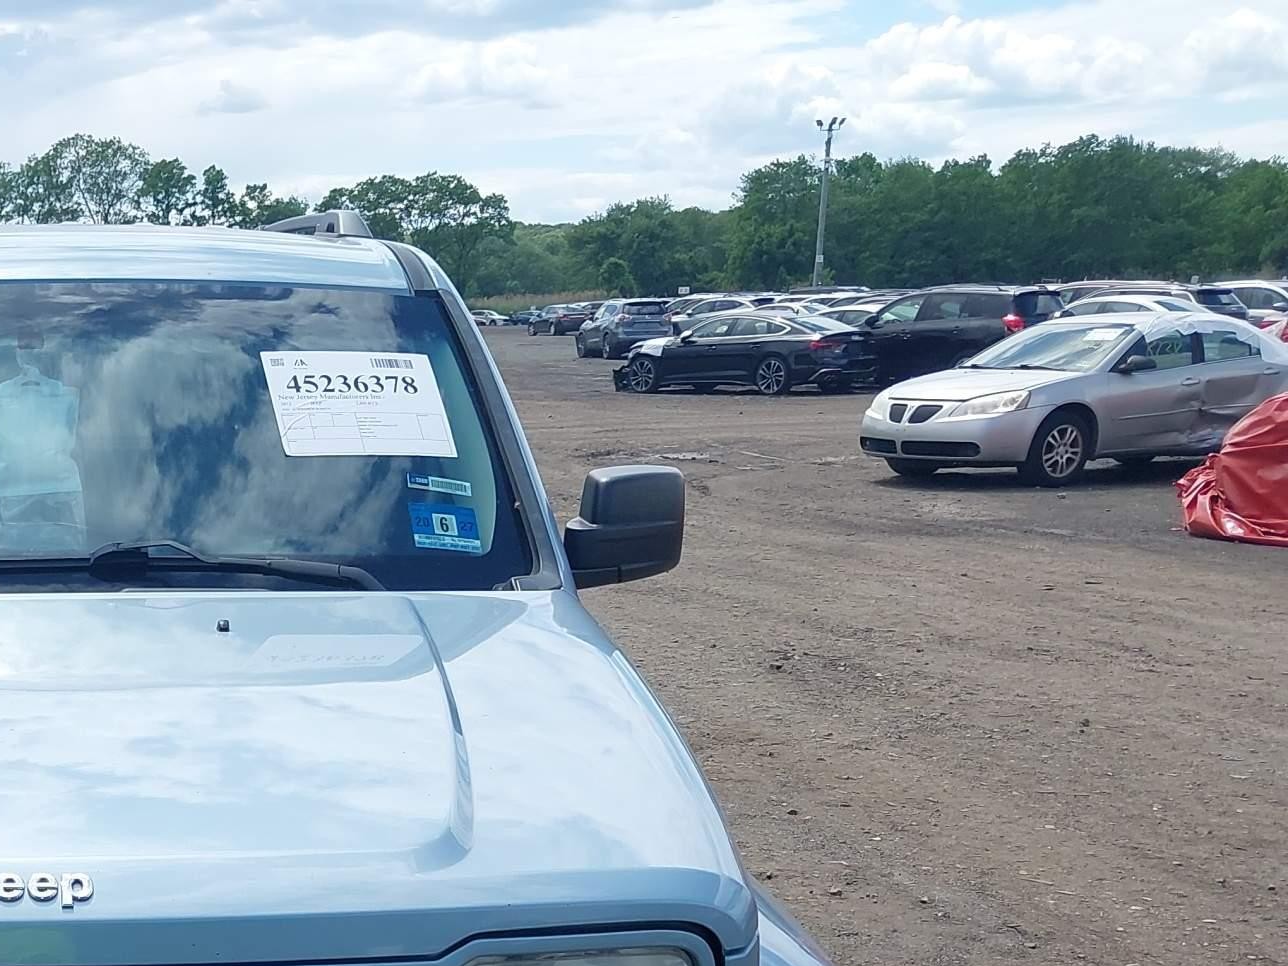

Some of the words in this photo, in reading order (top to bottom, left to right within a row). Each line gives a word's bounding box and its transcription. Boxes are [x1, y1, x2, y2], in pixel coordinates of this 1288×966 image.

[286, 375, 418, 394] 45236378
[416, 516, 430, 528] 20
[440, 517, 449, 532] 6
